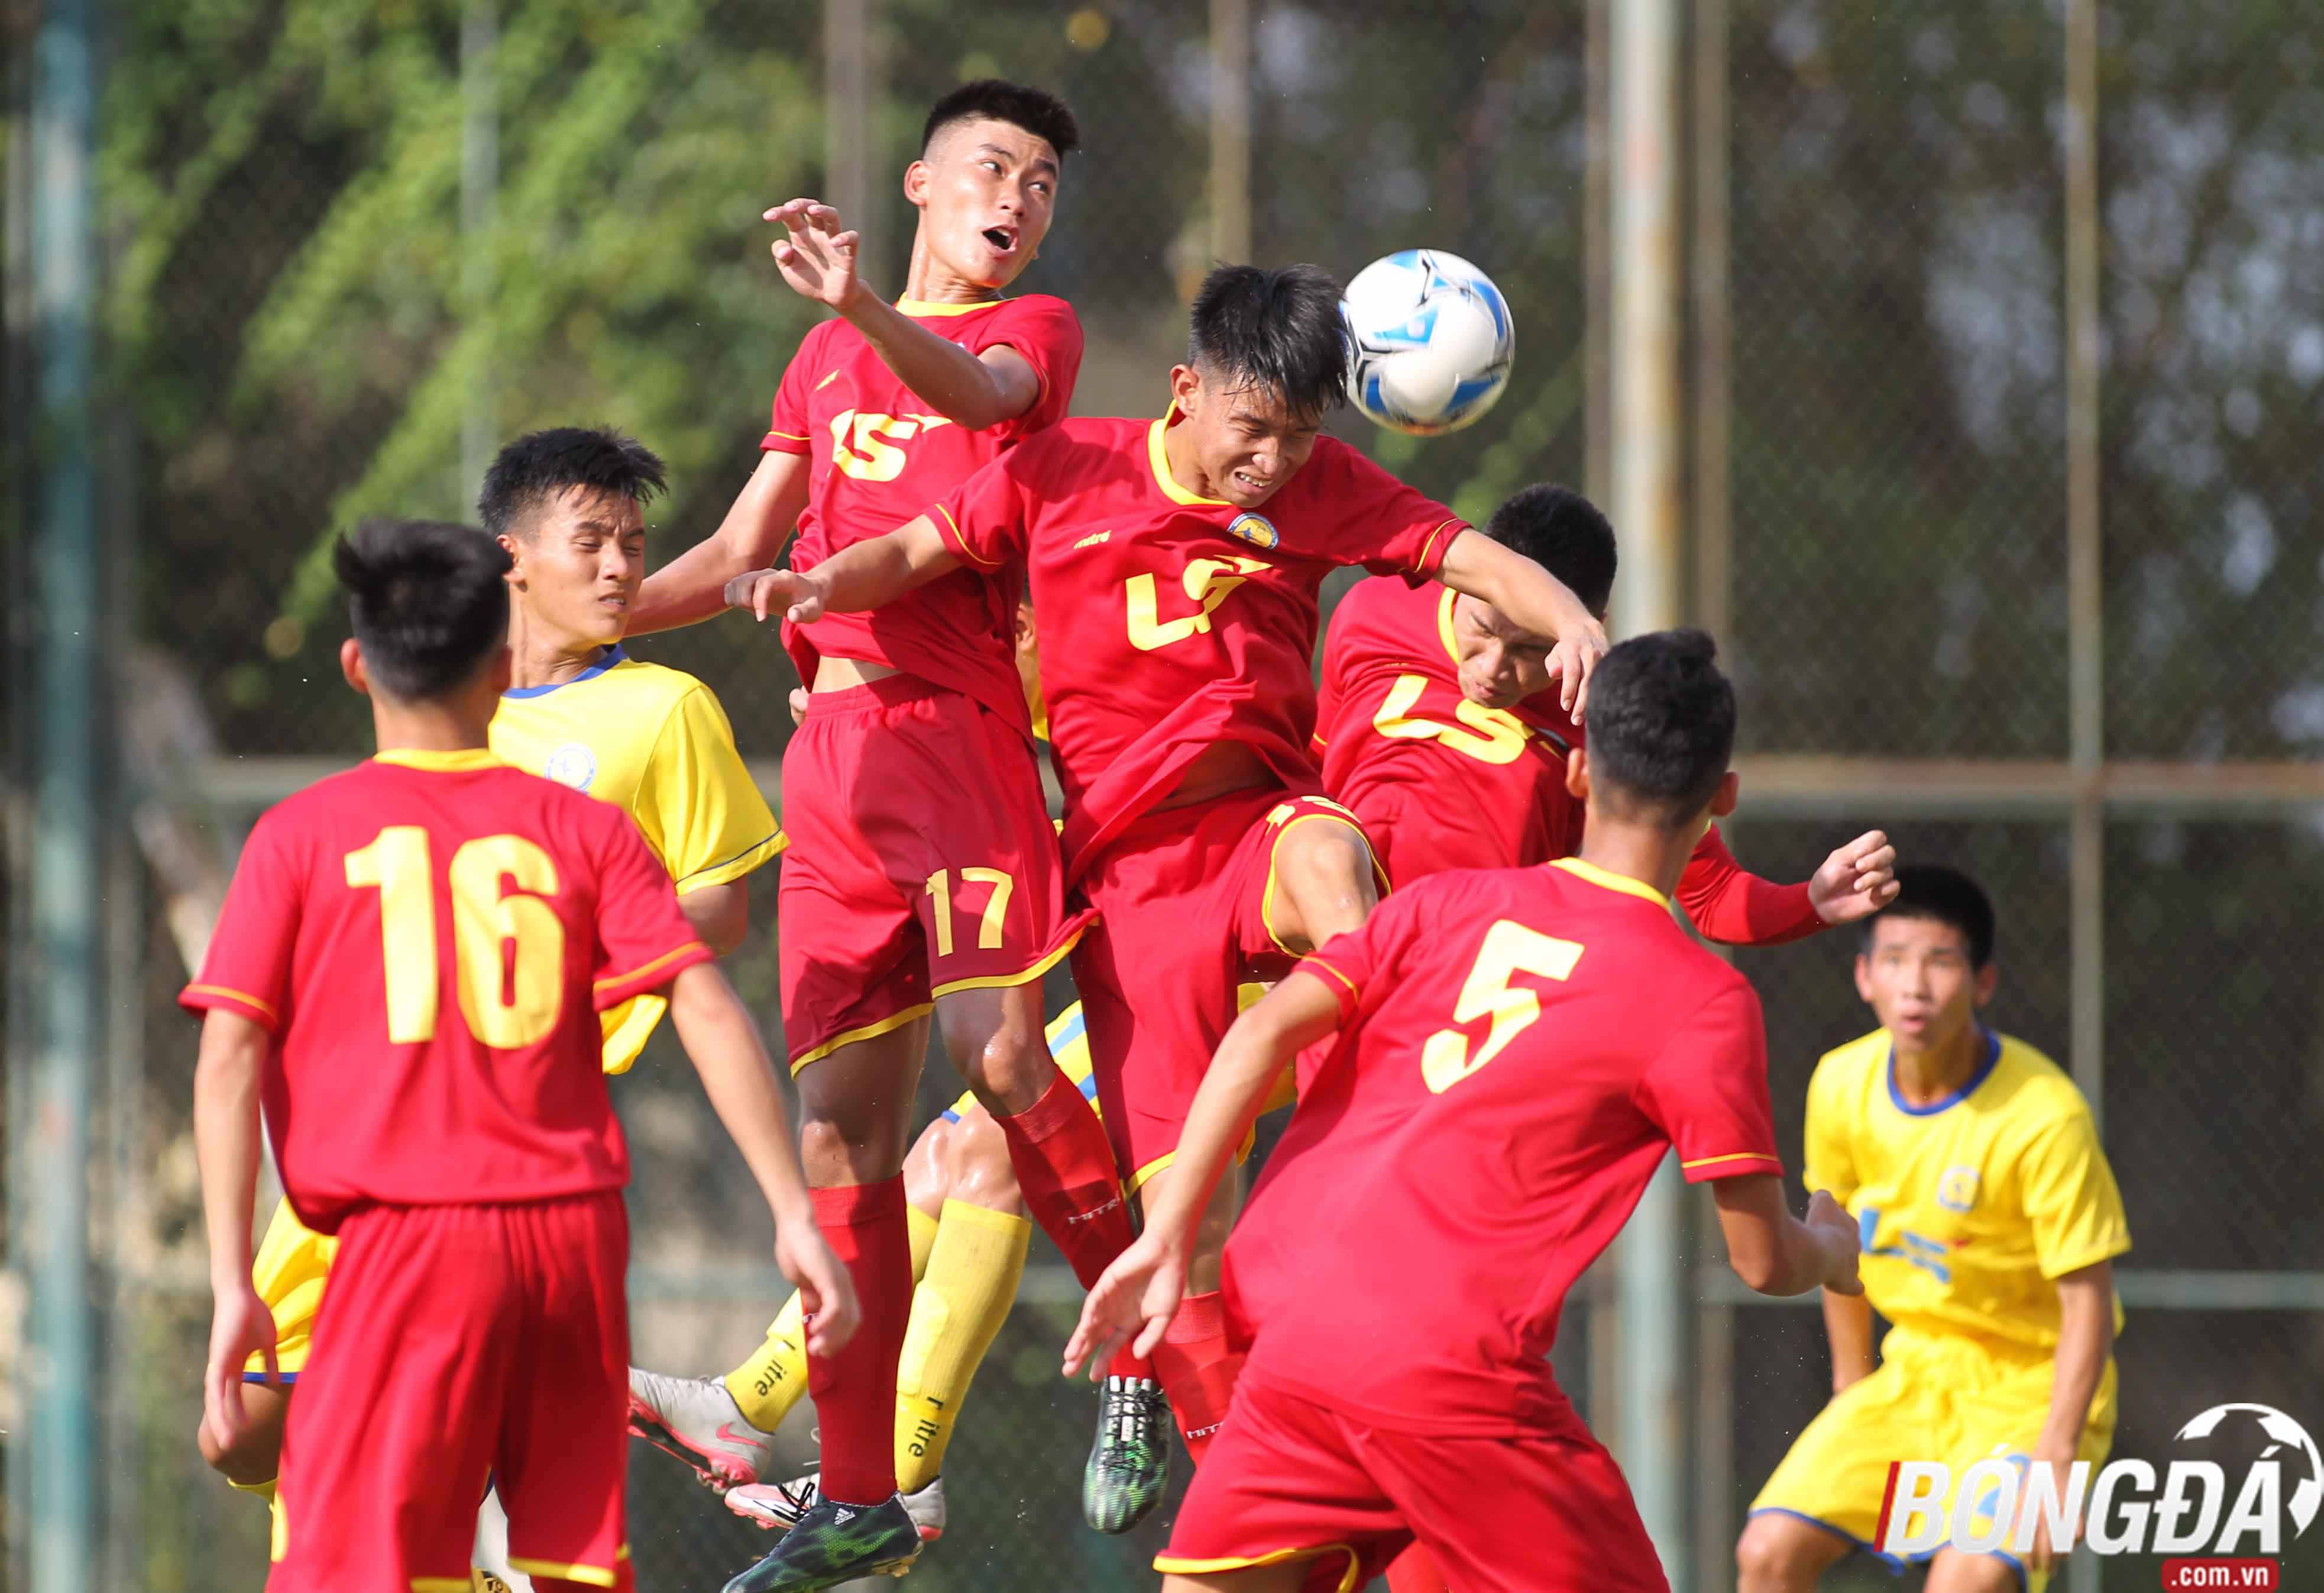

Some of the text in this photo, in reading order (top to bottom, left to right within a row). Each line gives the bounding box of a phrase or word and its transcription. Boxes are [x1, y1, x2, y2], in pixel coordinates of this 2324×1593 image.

[344, 825, 565, 1049] 16
[926, 866, 1013, 957] 17
[1421, 919, 1585, 1094] 5
